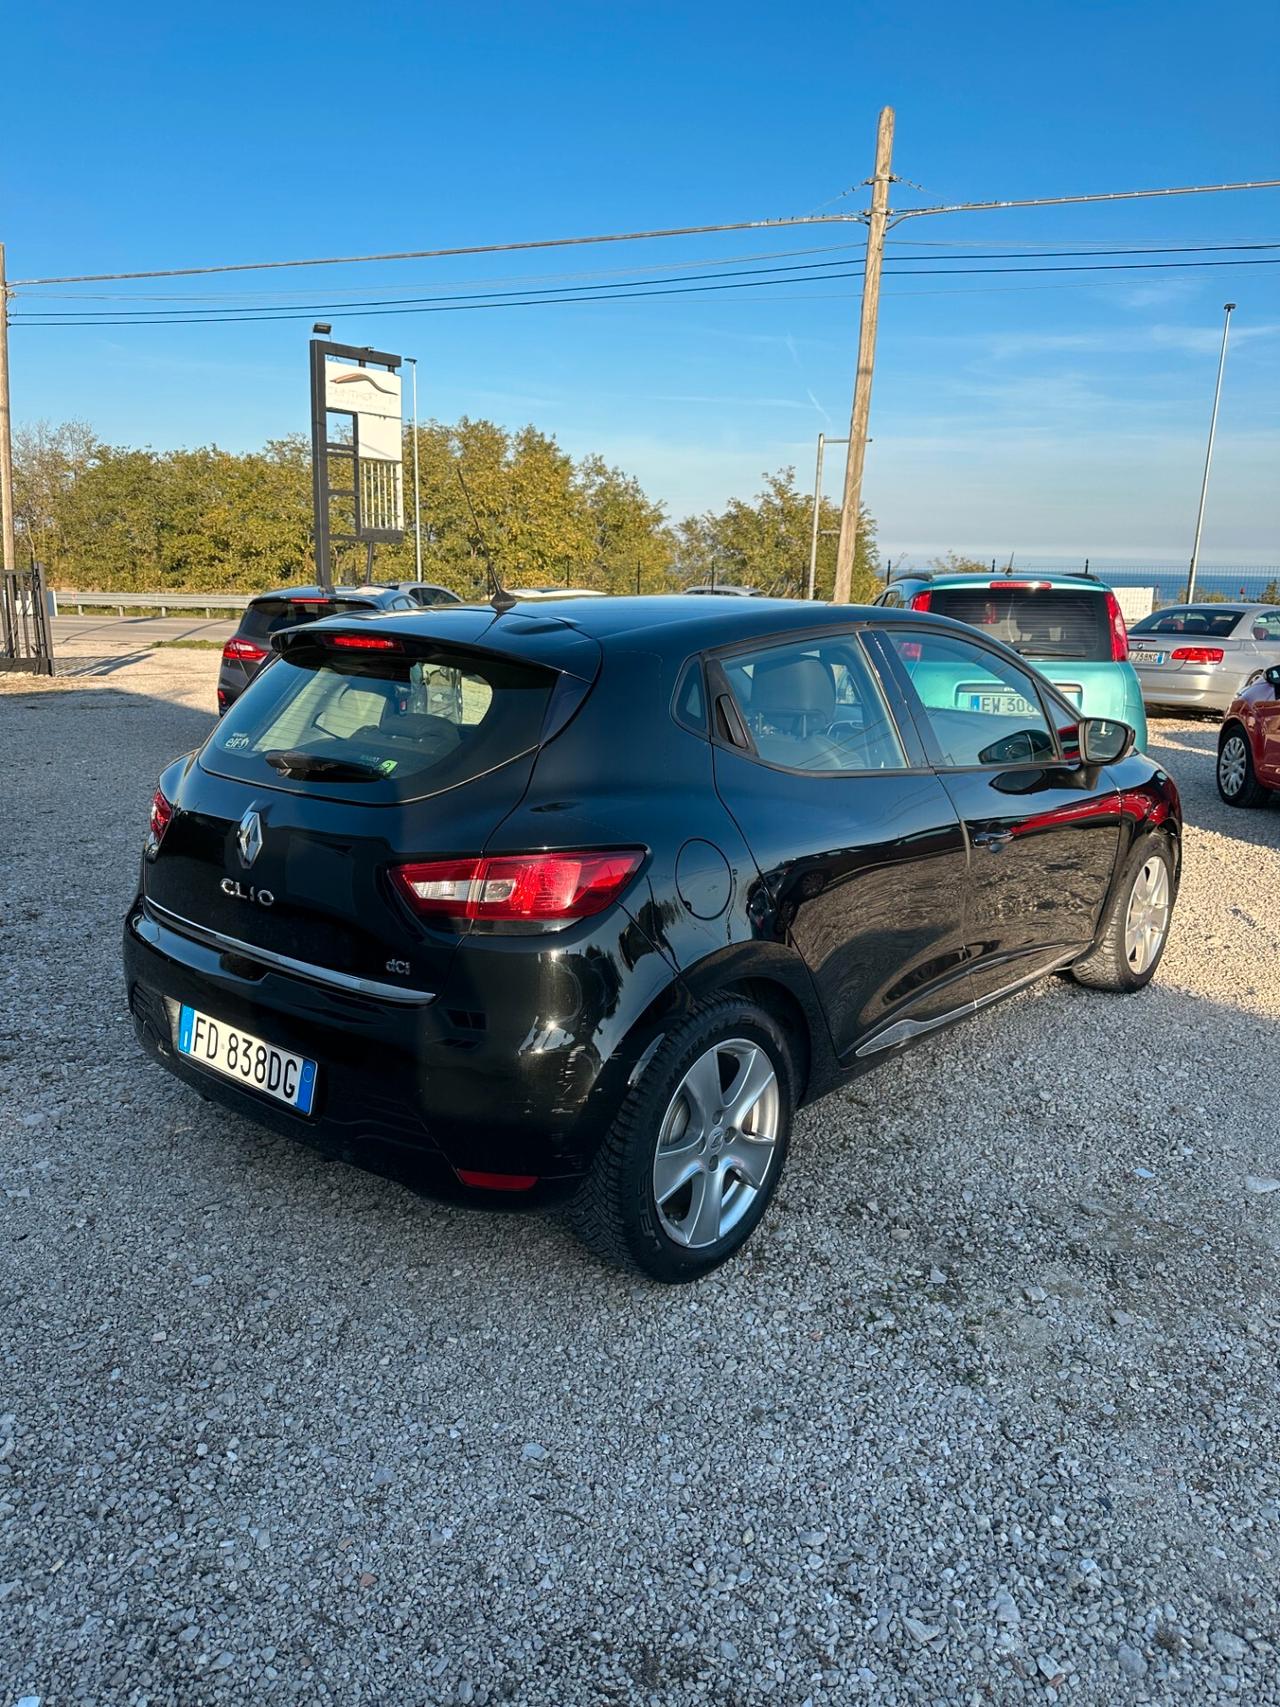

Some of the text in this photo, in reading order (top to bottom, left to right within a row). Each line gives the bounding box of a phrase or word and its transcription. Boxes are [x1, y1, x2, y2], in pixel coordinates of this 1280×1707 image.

[981, 697, 1001, 713] EW
[219, 877, 275, 907] CLIO
[192, 1016, 219, 1060] FD
[226, 1033, 298, 1099] 838DG
